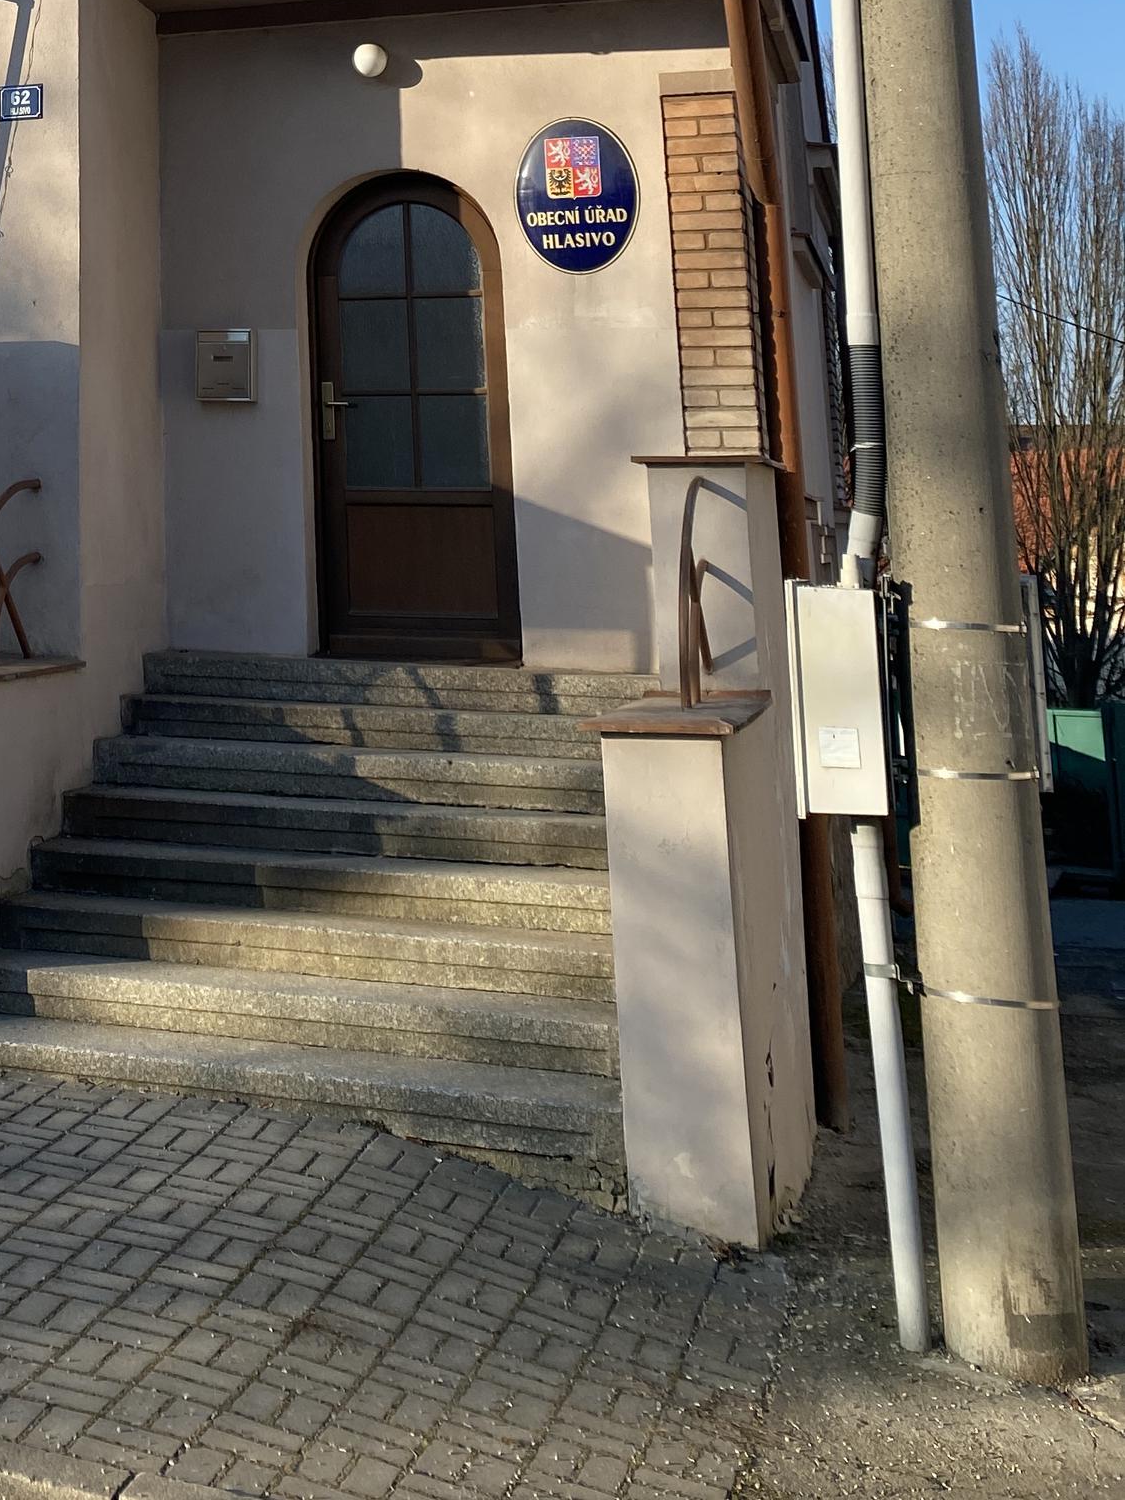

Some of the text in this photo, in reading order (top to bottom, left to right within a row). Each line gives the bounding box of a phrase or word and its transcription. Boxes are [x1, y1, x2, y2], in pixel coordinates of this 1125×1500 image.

[10, 90, 31, 106] 62
[526, 204, 628, 227] OBECNÍ ÚŘAD
[542, 231, 616, 250] HLASIVO
